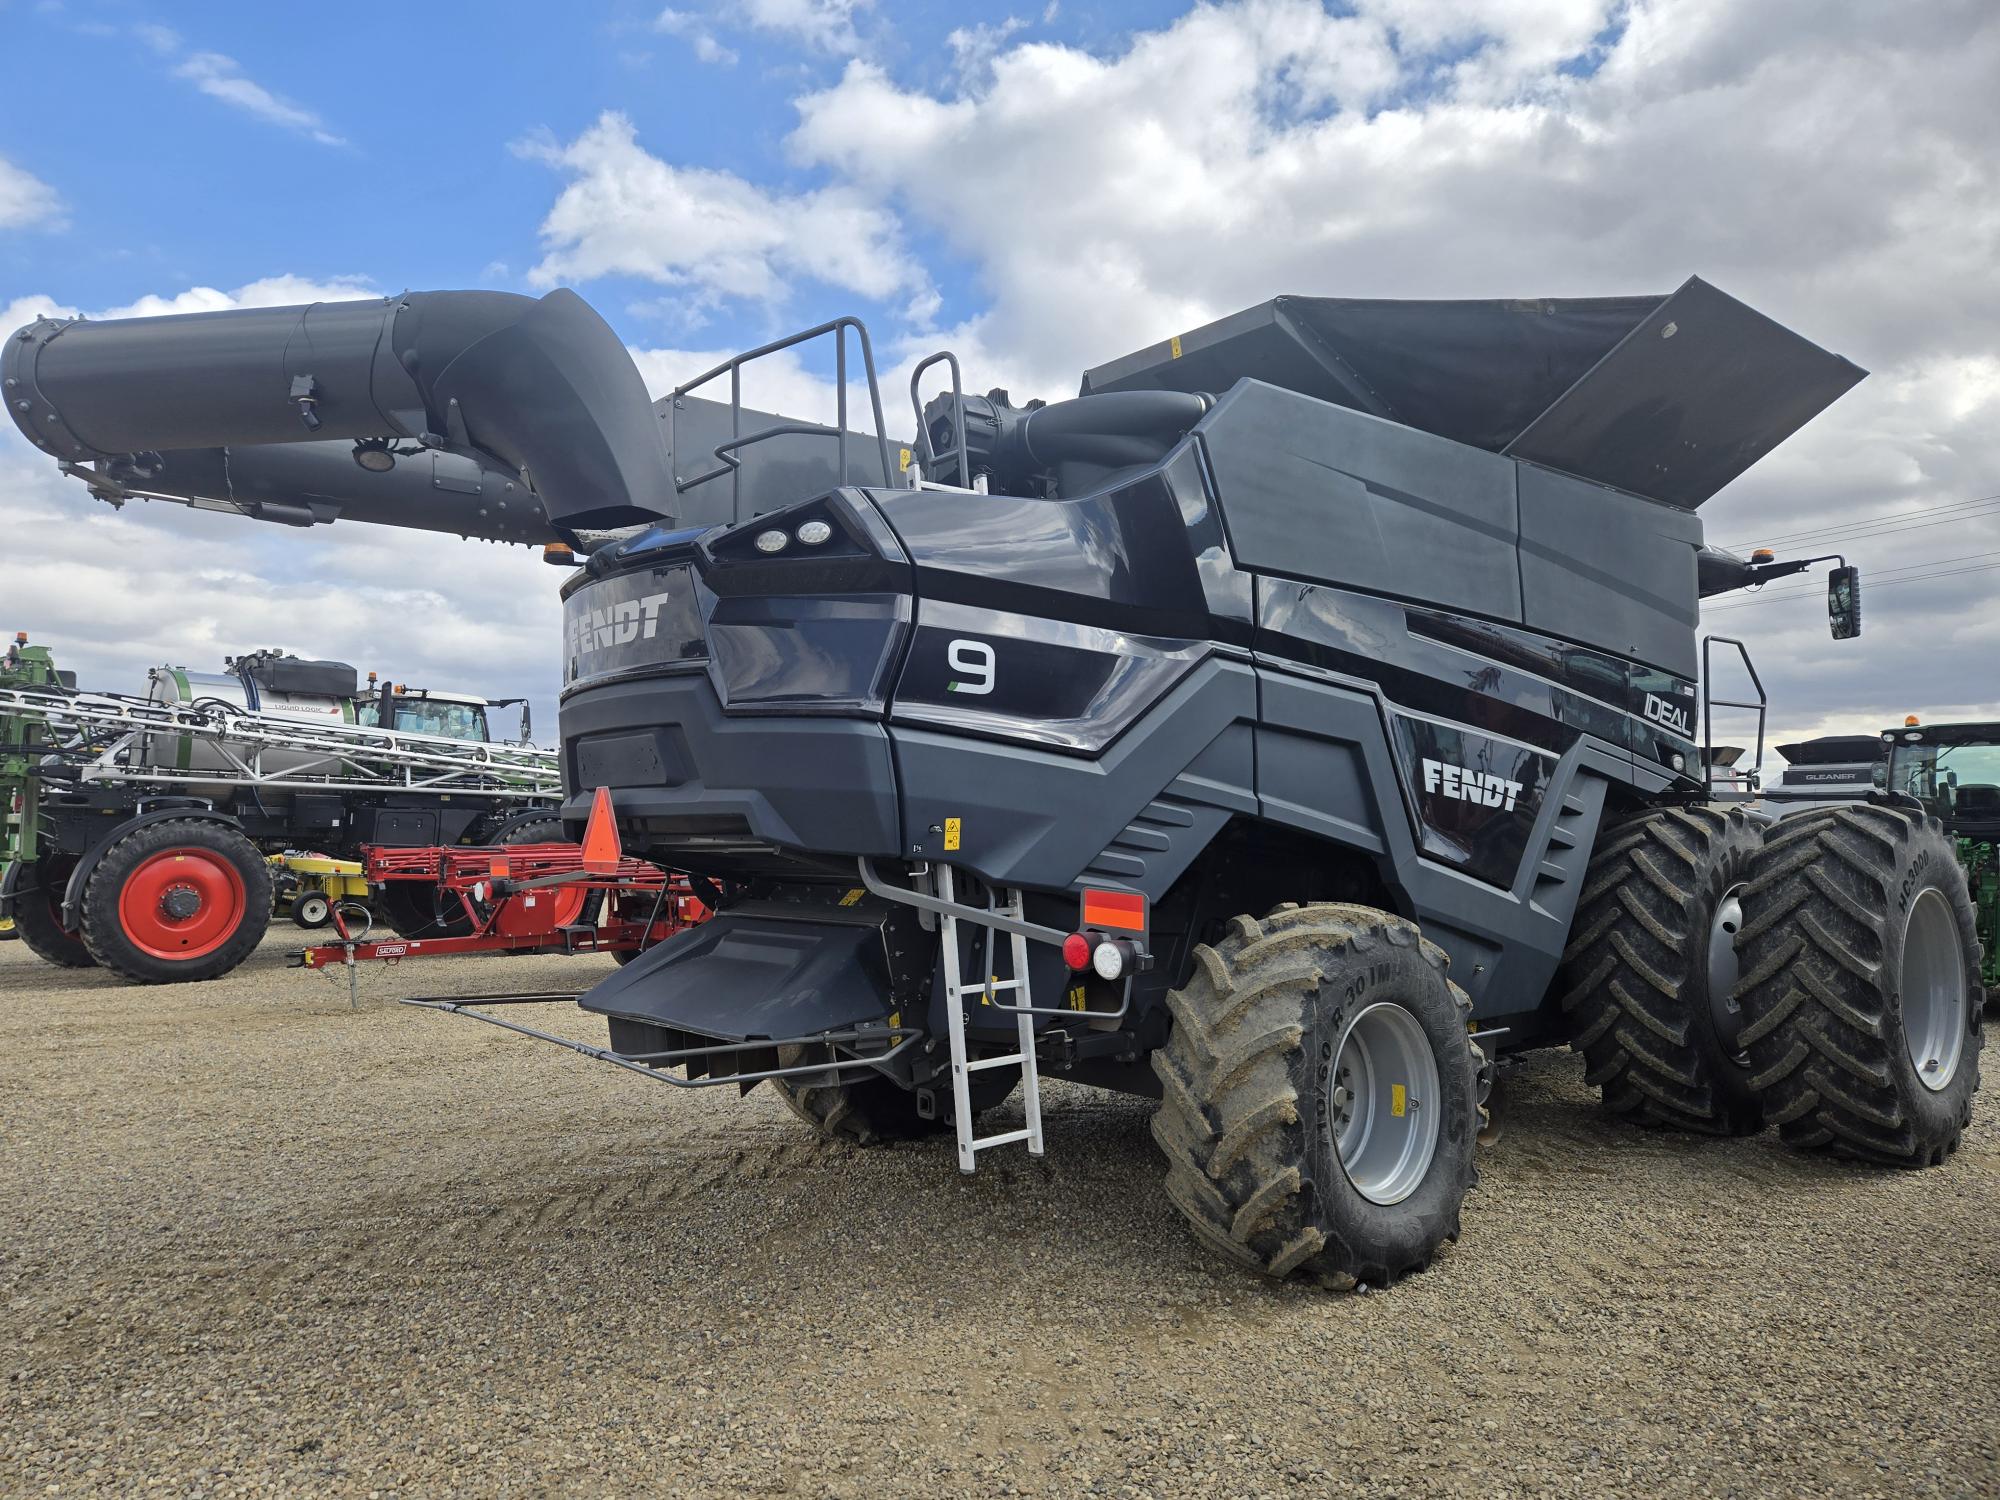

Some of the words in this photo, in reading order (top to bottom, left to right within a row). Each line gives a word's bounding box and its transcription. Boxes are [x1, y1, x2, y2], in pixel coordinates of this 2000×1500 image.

[567, 592, 669, 657] FENDT
[947, 639, 995, 694] 9
[1644, 692, 1692, 737] IDEAL
[1422, 757, 1524, 812] FENDT
[1345, 975, 1365, 1007] 30
